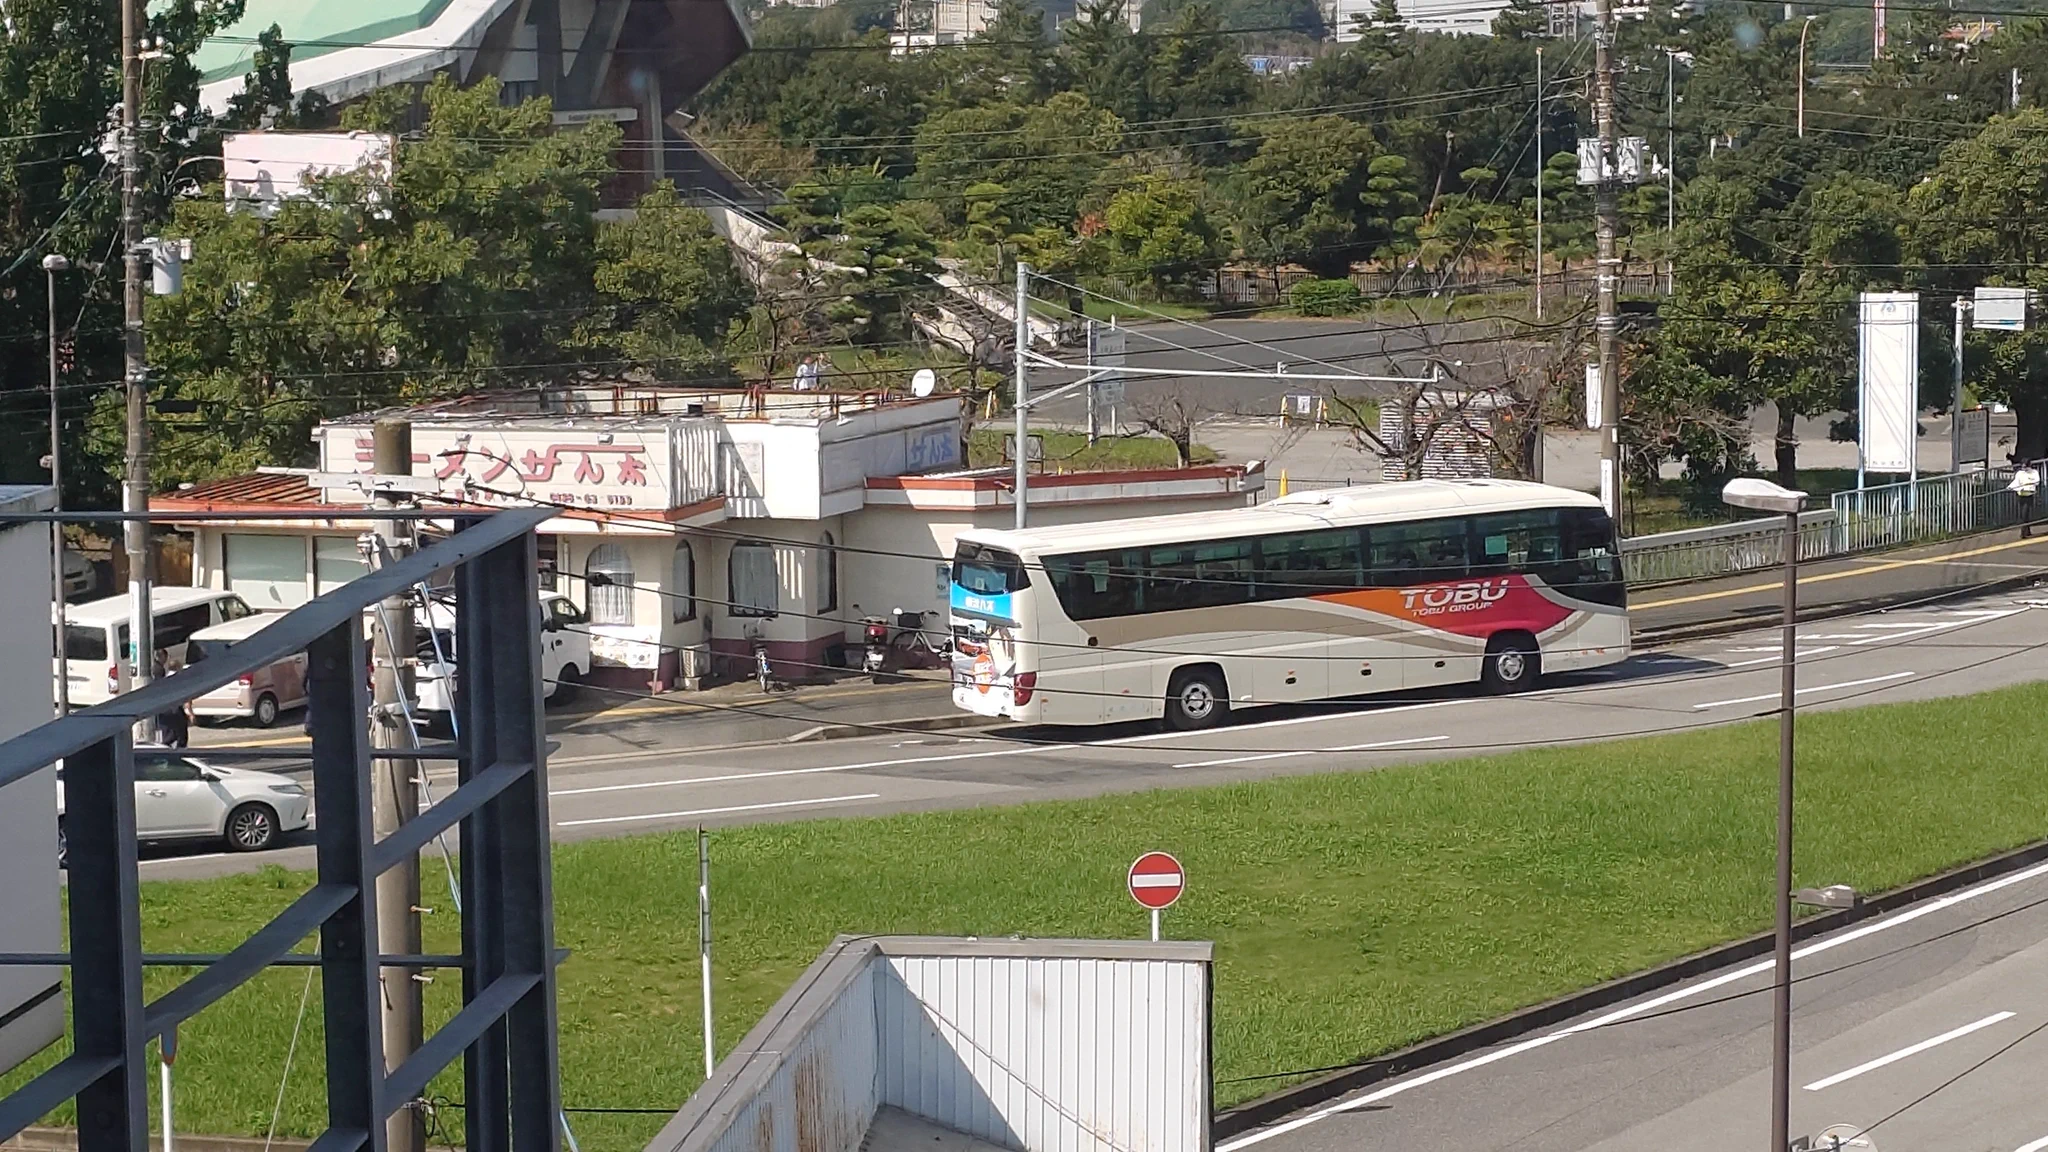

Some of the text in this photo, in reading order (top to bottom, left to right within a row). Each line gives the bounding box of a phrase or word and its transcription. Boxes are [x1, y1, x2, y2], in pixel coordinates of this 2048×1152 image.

[1400, 579, 1509, 609] TOBU
[1412, 601, 1493, 617] TOBU GROUP
